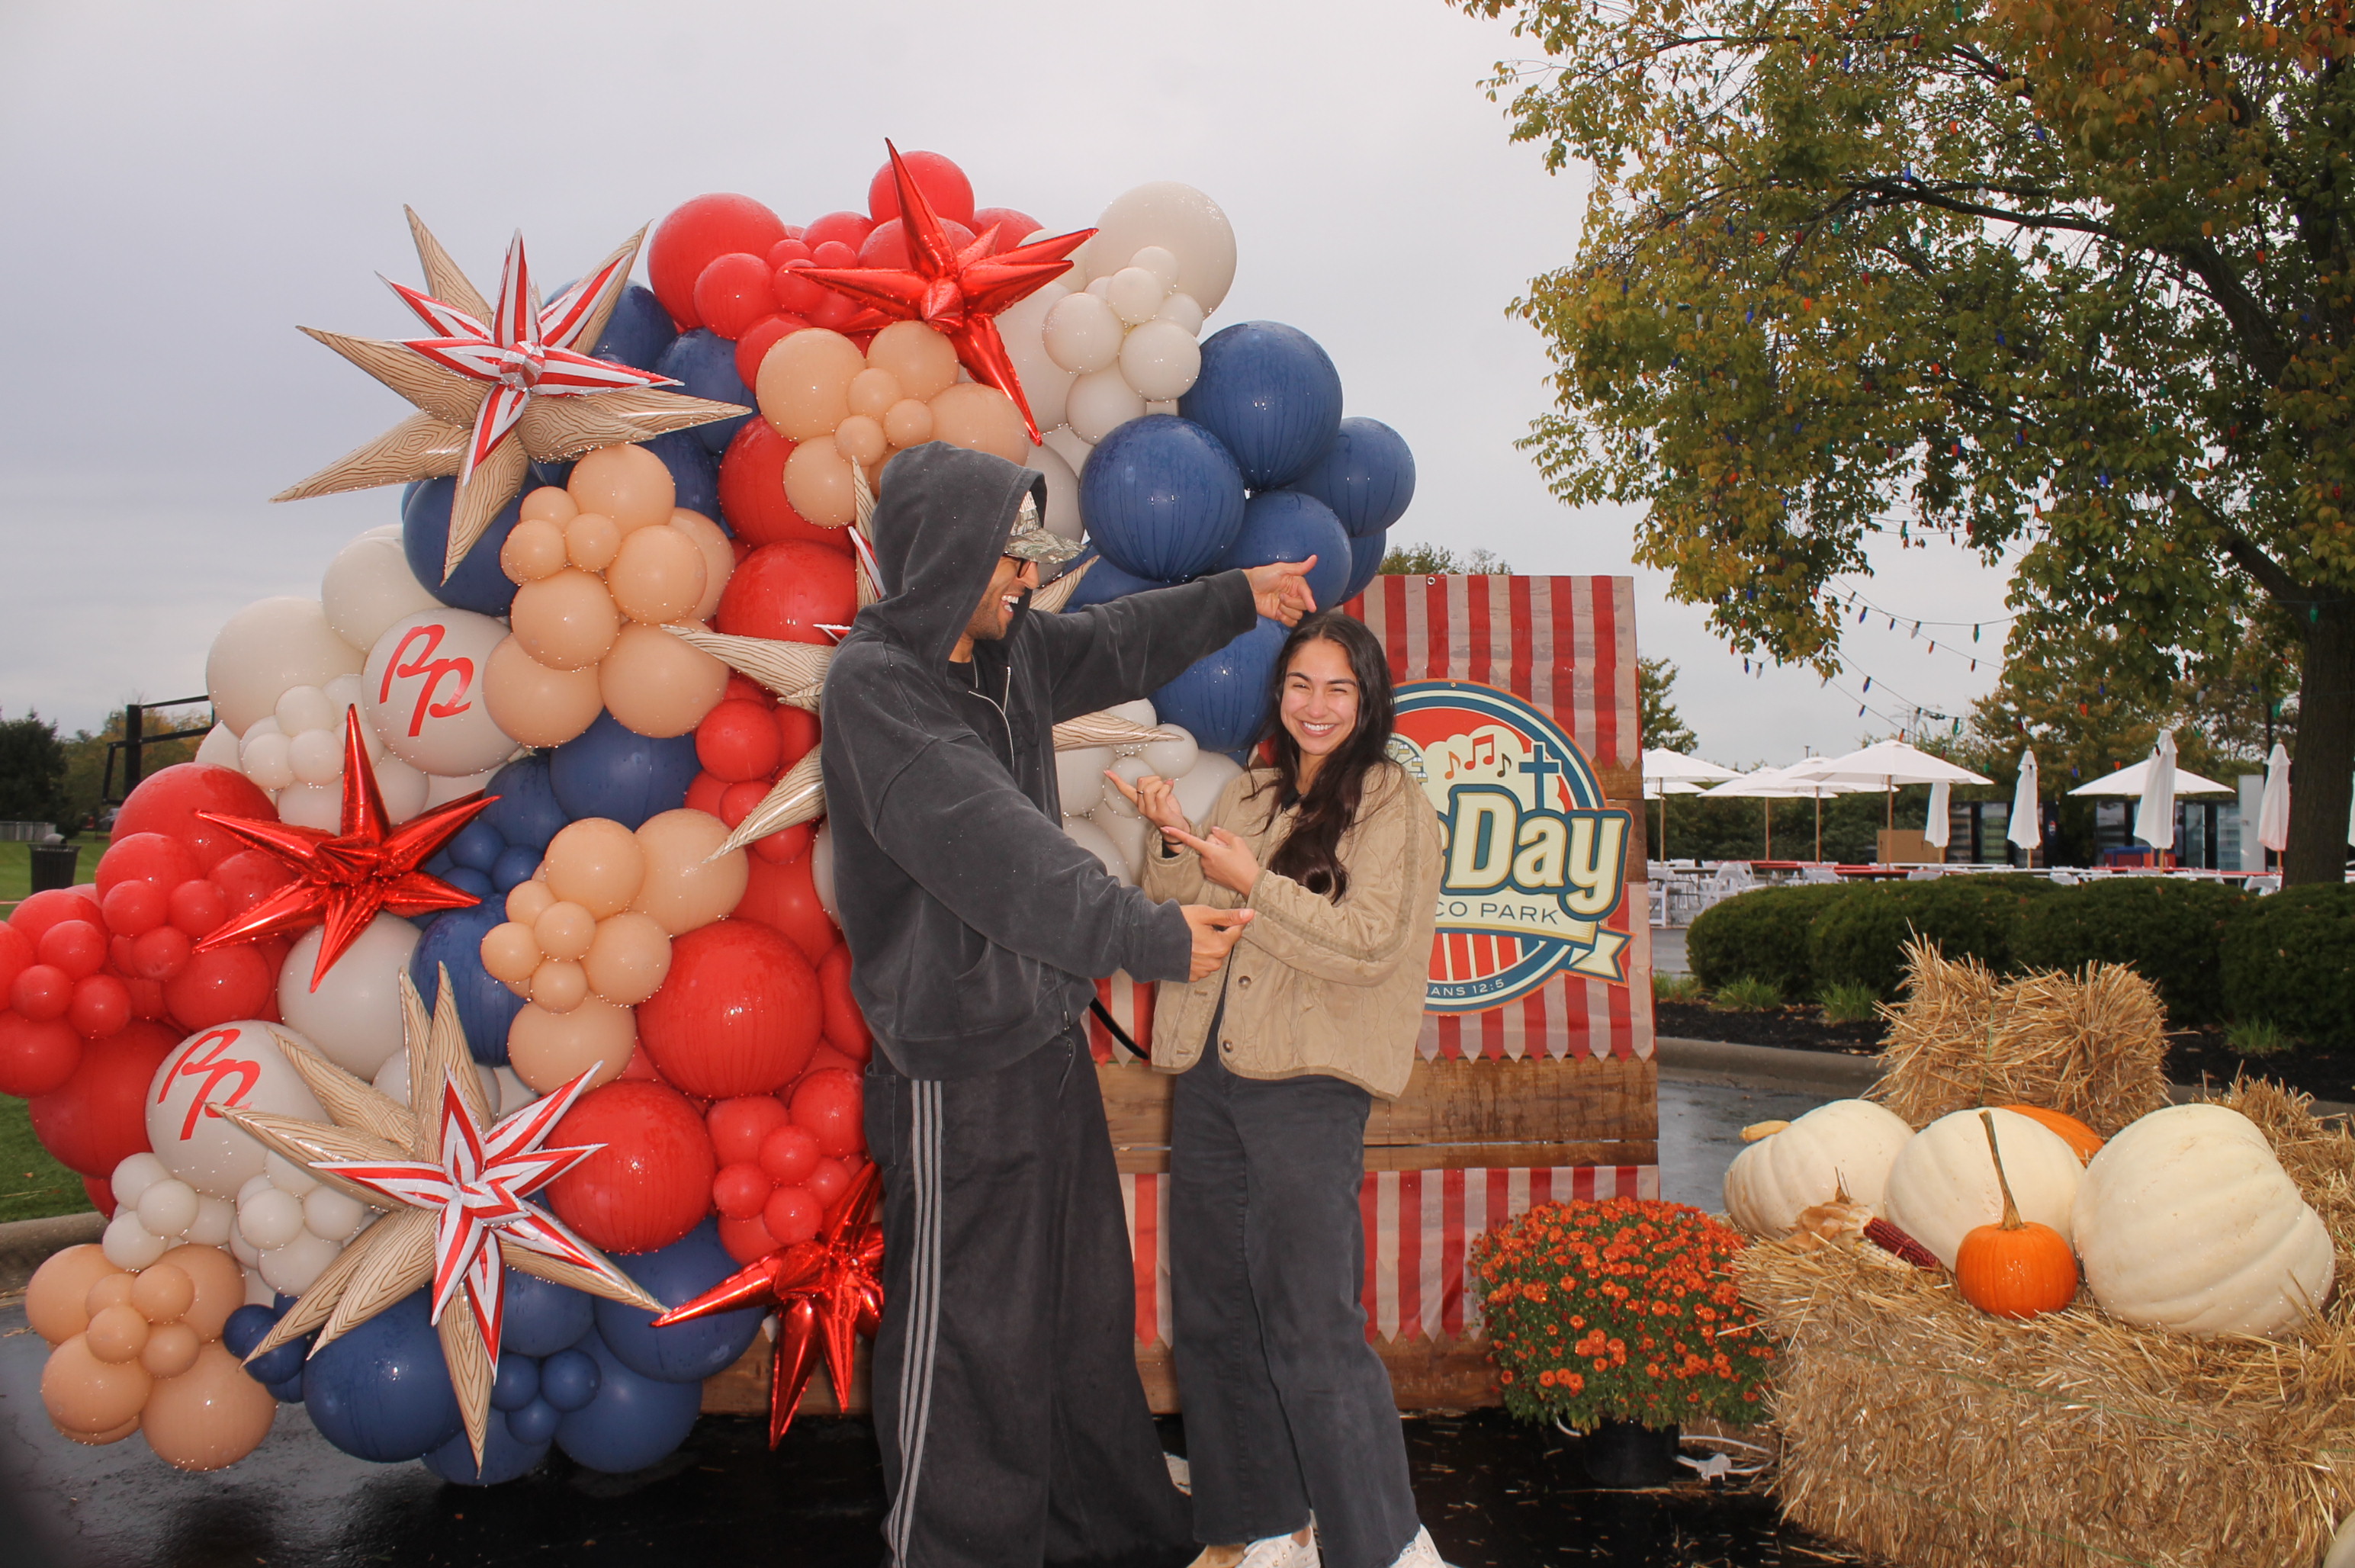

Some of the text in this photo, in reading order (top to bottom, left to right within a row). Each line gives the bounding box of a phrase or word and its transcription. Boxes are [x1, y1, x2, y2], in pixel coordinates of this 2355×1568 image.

[1439, 792, 1626, 915] Day
[1480, 902, 1559, 926] PARK
[1426, 978, 1504, 997] ANS 12:5
